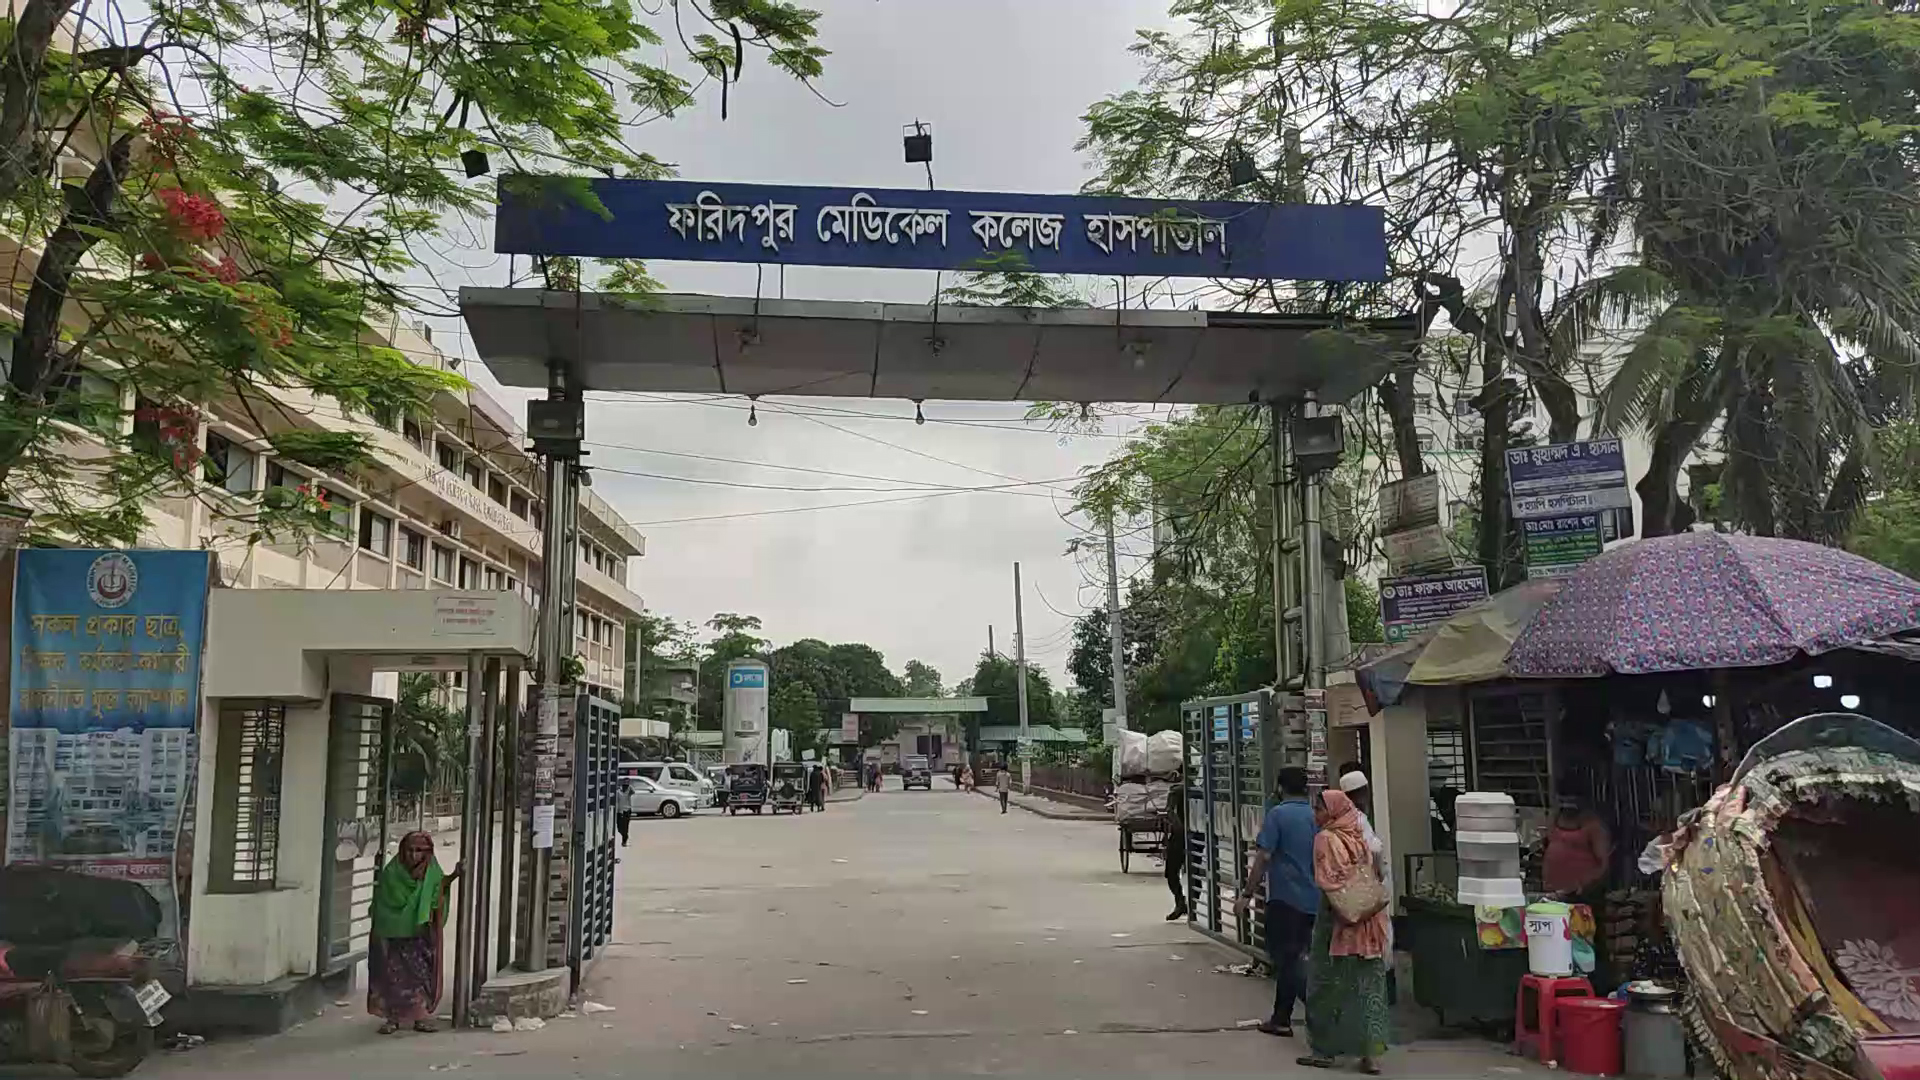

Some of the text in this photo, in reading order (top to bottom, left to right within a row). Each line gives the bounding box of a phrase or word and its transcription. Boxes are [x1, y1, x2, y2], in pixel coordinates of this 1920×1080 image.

[665, 190, 1231, 257] ফরিদপুর মেডিকেল কলেজ হাসপাতাল
